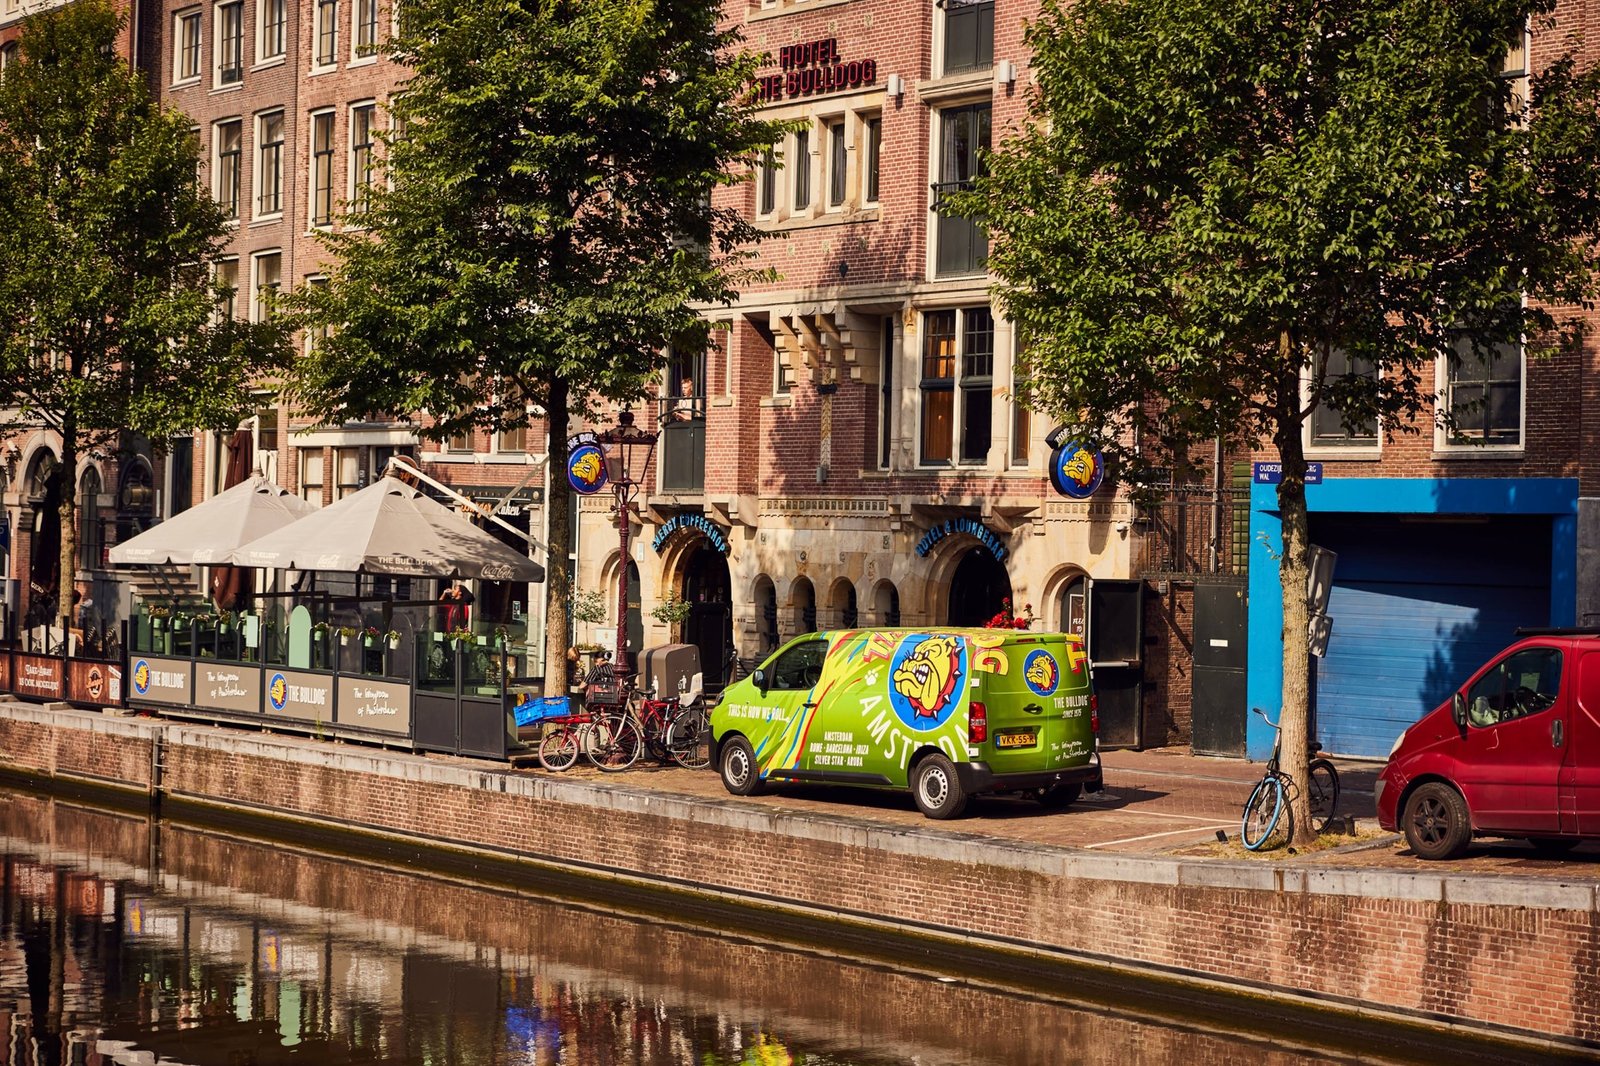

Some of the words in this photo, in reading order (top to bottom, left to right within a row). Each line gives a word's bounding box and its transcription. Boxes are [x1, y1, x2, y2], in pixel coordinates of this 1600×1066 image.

[780, 38, 841, 71] HOTEL
[749, 75, 781, 104] THE
[786, 59, 876, 98] BULLDOG
[1259, 464, 1283, 474] OUDEZIJ
[1259, 473, 1270, 481] WAL
[652, 516, 677, 551] ENERGY
[680, 513, 726, 552] COFFEESHOP
[915, 526, 943, 557] HOTEL
[954, 518, 1004, 560] LOUNGEBAR
[378, 556, 394, 564] THE
[151, 666, 161, 687] THE
[211, 689, 217, 699] of
[288, 685, 299, 702] THE
[1053, 697, 1065, 709] THE
[357, 706, 364, 717] of
[728, 703, 741, 718] THIS
[741, 705, 748, 718] IS
[748, 705, 761, 719] HOW
[761, 707, 771, 720] WE
[824, 731, 853, 742] AMSTERDAM
[810, 742, 823, 753] ROME
[825, 743, 853, 755] BARCELONA
[855, 744, 869, 755] IBIZA
[814, 754, 831, 766] SILVER
[831, 755, 844, 766] STAR
[847, 756, 863, 767] ARUBA
